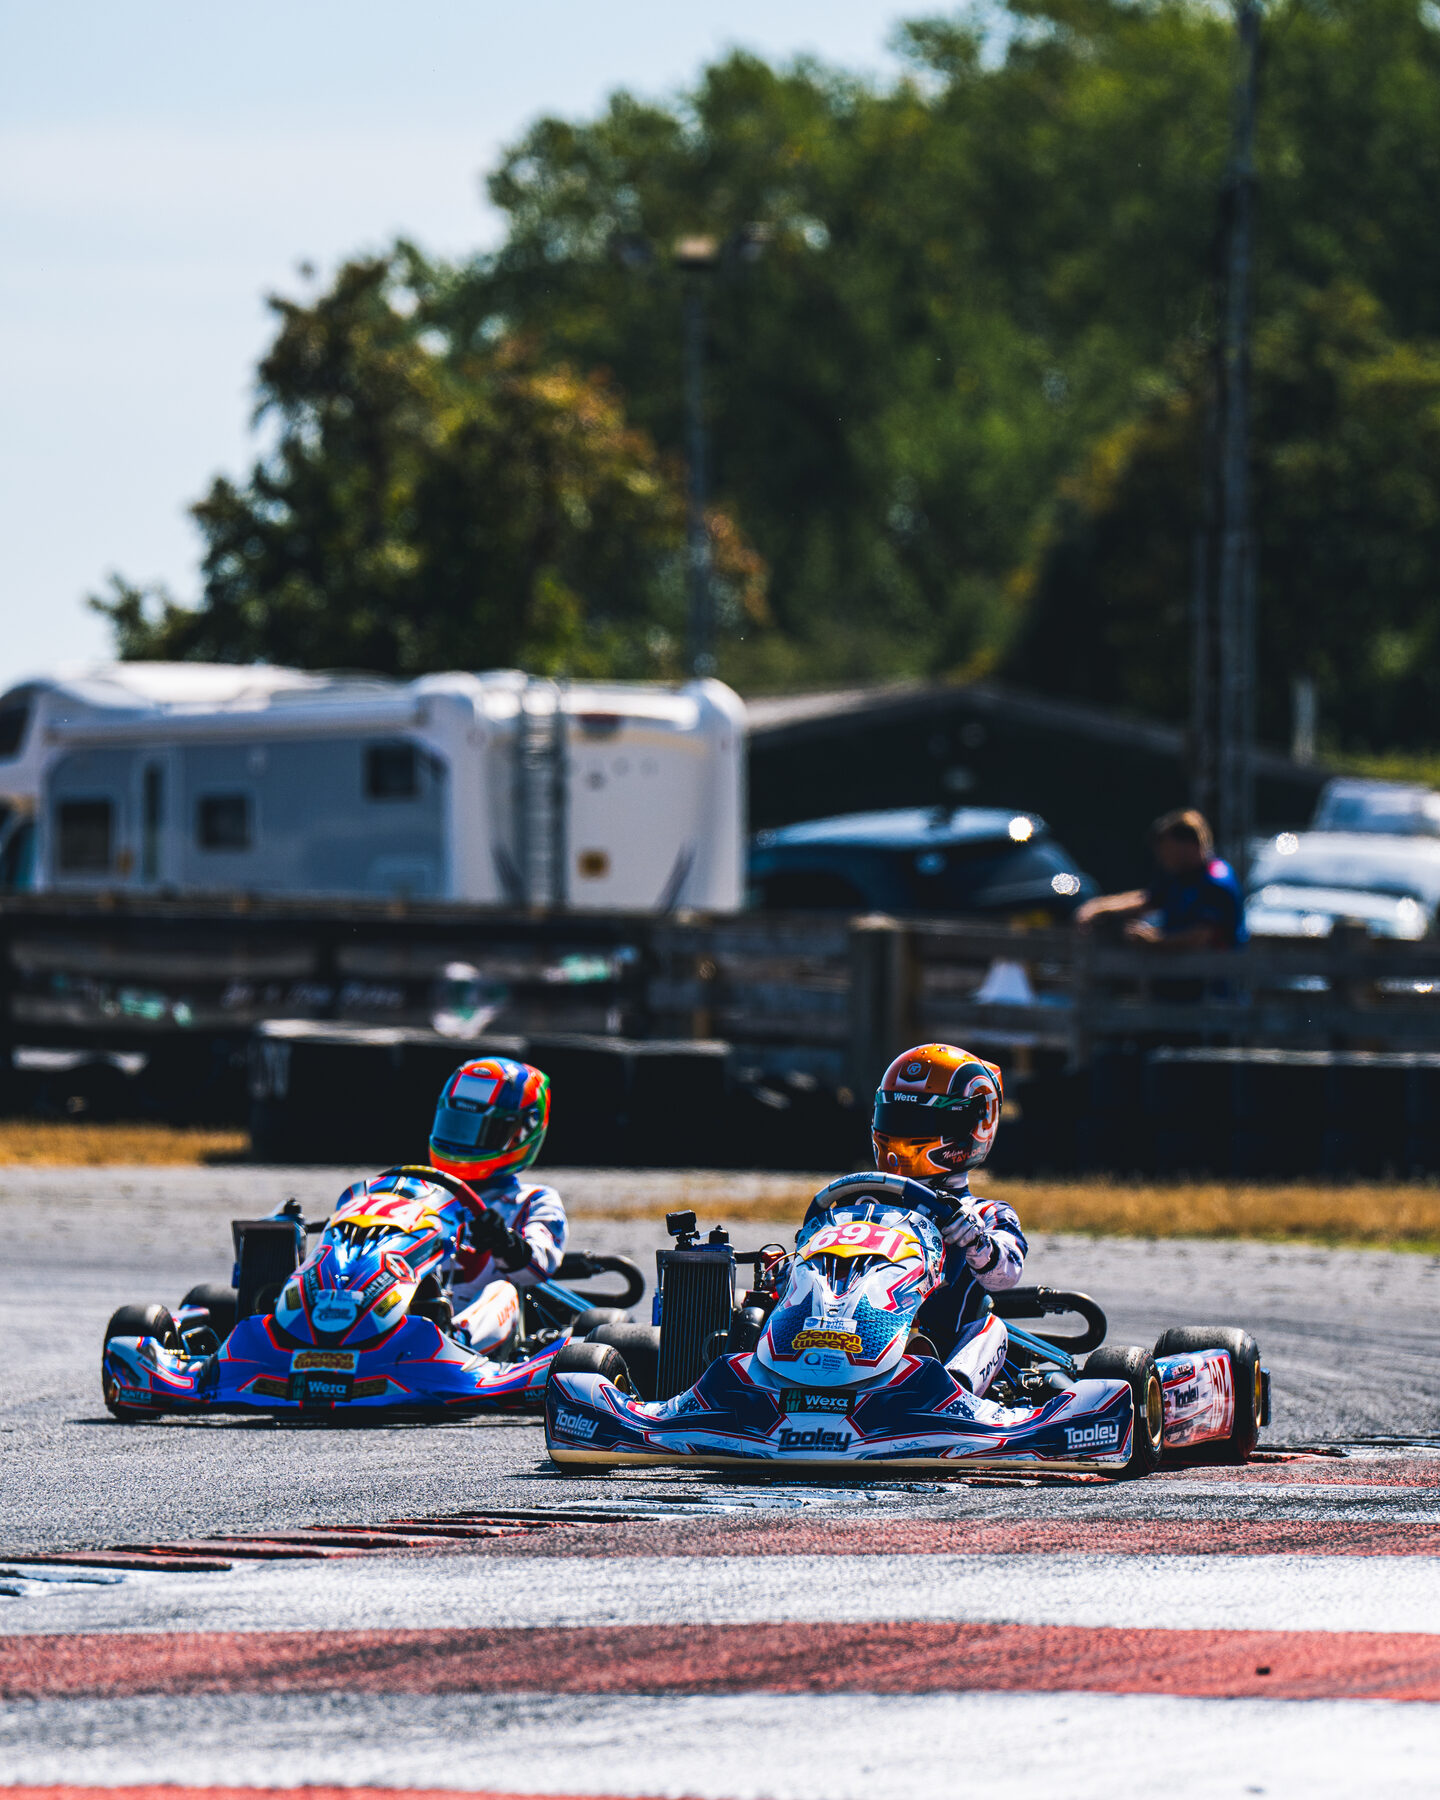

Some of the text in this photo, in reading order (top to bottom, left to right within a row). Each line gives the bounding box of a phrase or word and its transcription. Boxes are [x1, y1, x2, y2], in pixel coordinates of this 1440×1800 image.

[894, 1093, 918, 1103] Wera
[952, 1147, 982, 1164] TAYLOR
[809, 1223, 898, 1257] 691
[796, 1330, 860, 1345] demon
[792, 1339, 862, 1353] tweeks
[308, 1381, 347, 1394] Wera
[805, 1395, 849, 1407] Wera
[555, 1409, 599, 1438] Tooley
[778, 1427, 852, 1452] Tooley
[1064, 1424, 1119, 1444] Tooley
